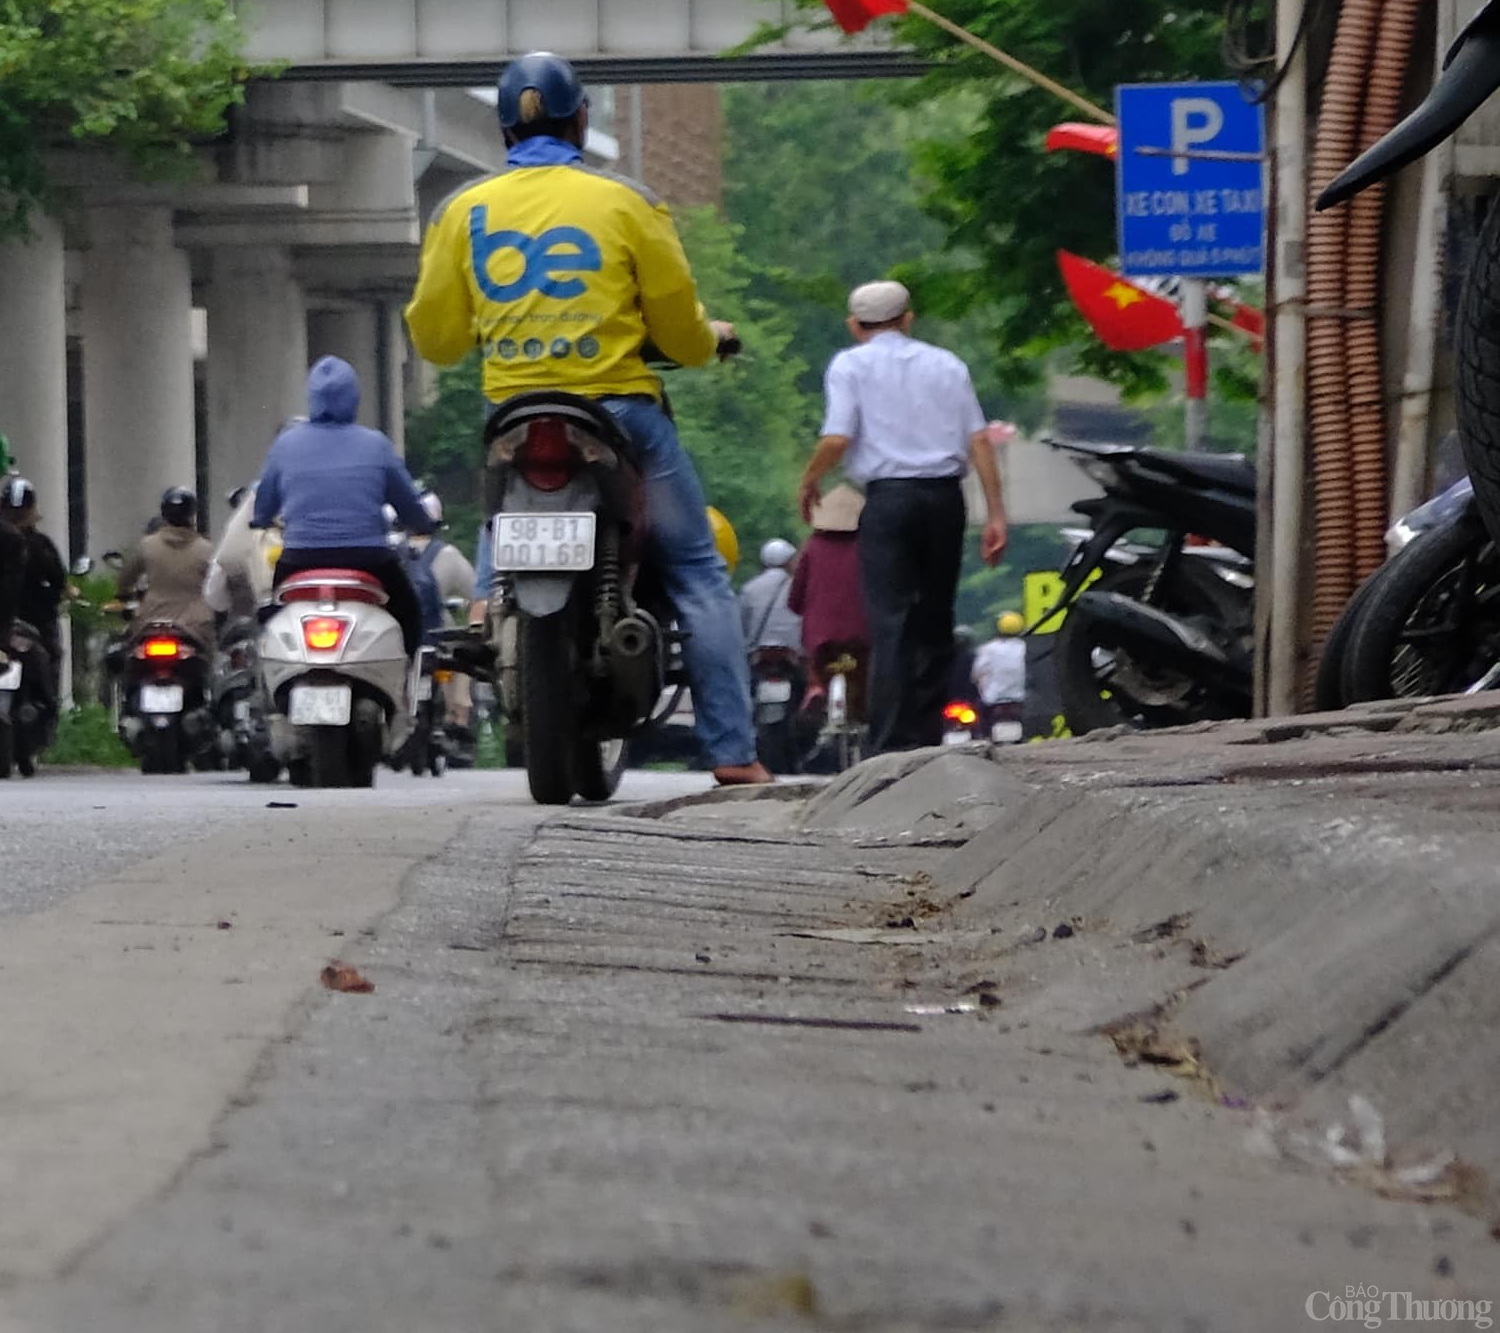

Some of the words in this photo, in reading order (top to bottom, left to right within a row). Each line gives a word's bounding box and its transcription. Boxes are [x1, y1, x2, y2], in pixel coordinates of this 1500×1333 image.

[1171, 97, 1224, 175] P
[471, 205, 602, 303] be
[510, 518, 579, 541] 98-B1
